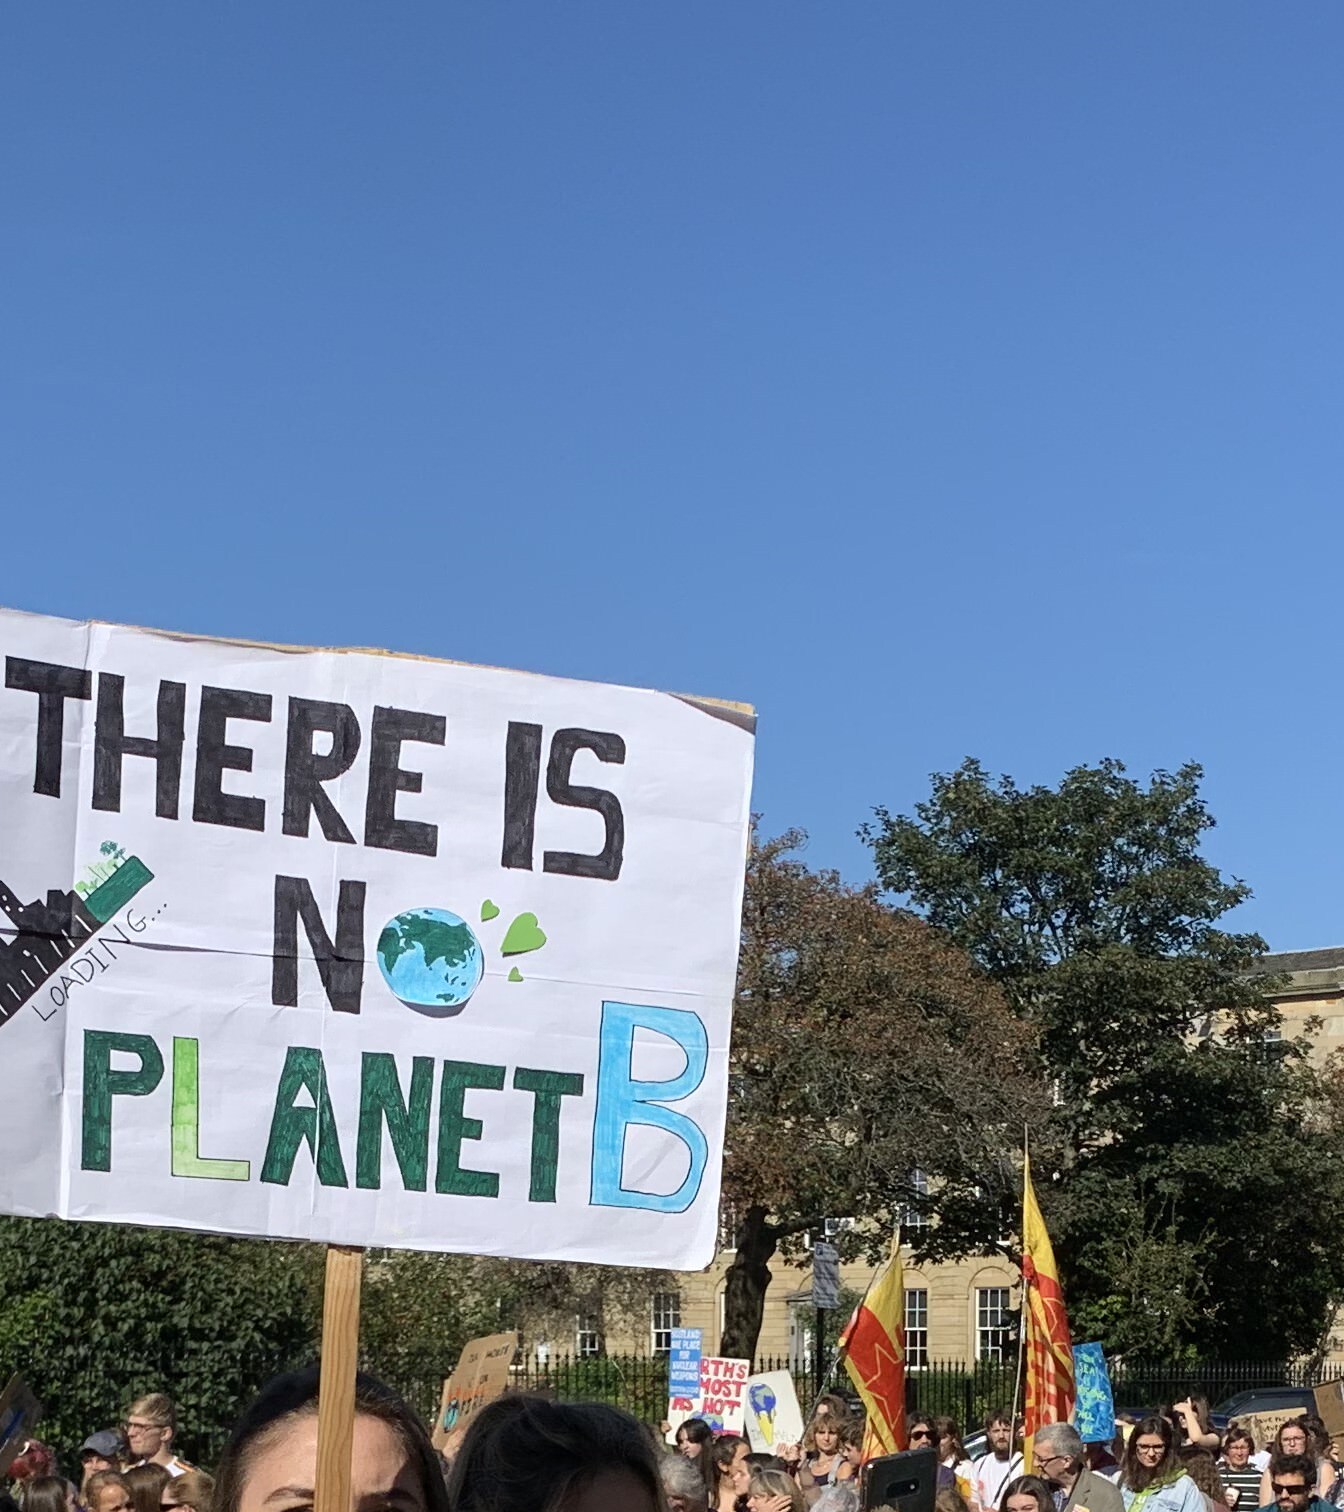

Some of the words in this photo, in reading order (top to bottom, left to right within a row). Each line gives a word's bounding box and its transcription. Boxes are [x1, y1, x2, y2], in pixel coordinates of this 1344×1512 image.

[4, 655, 447, 857] THERE
[501, 720, 626, 881] IS
[80, 1027, 585, 1204] PLANET
[589, 999, 709, 1214] B
[702, 1397, 741, 1416] HOT
